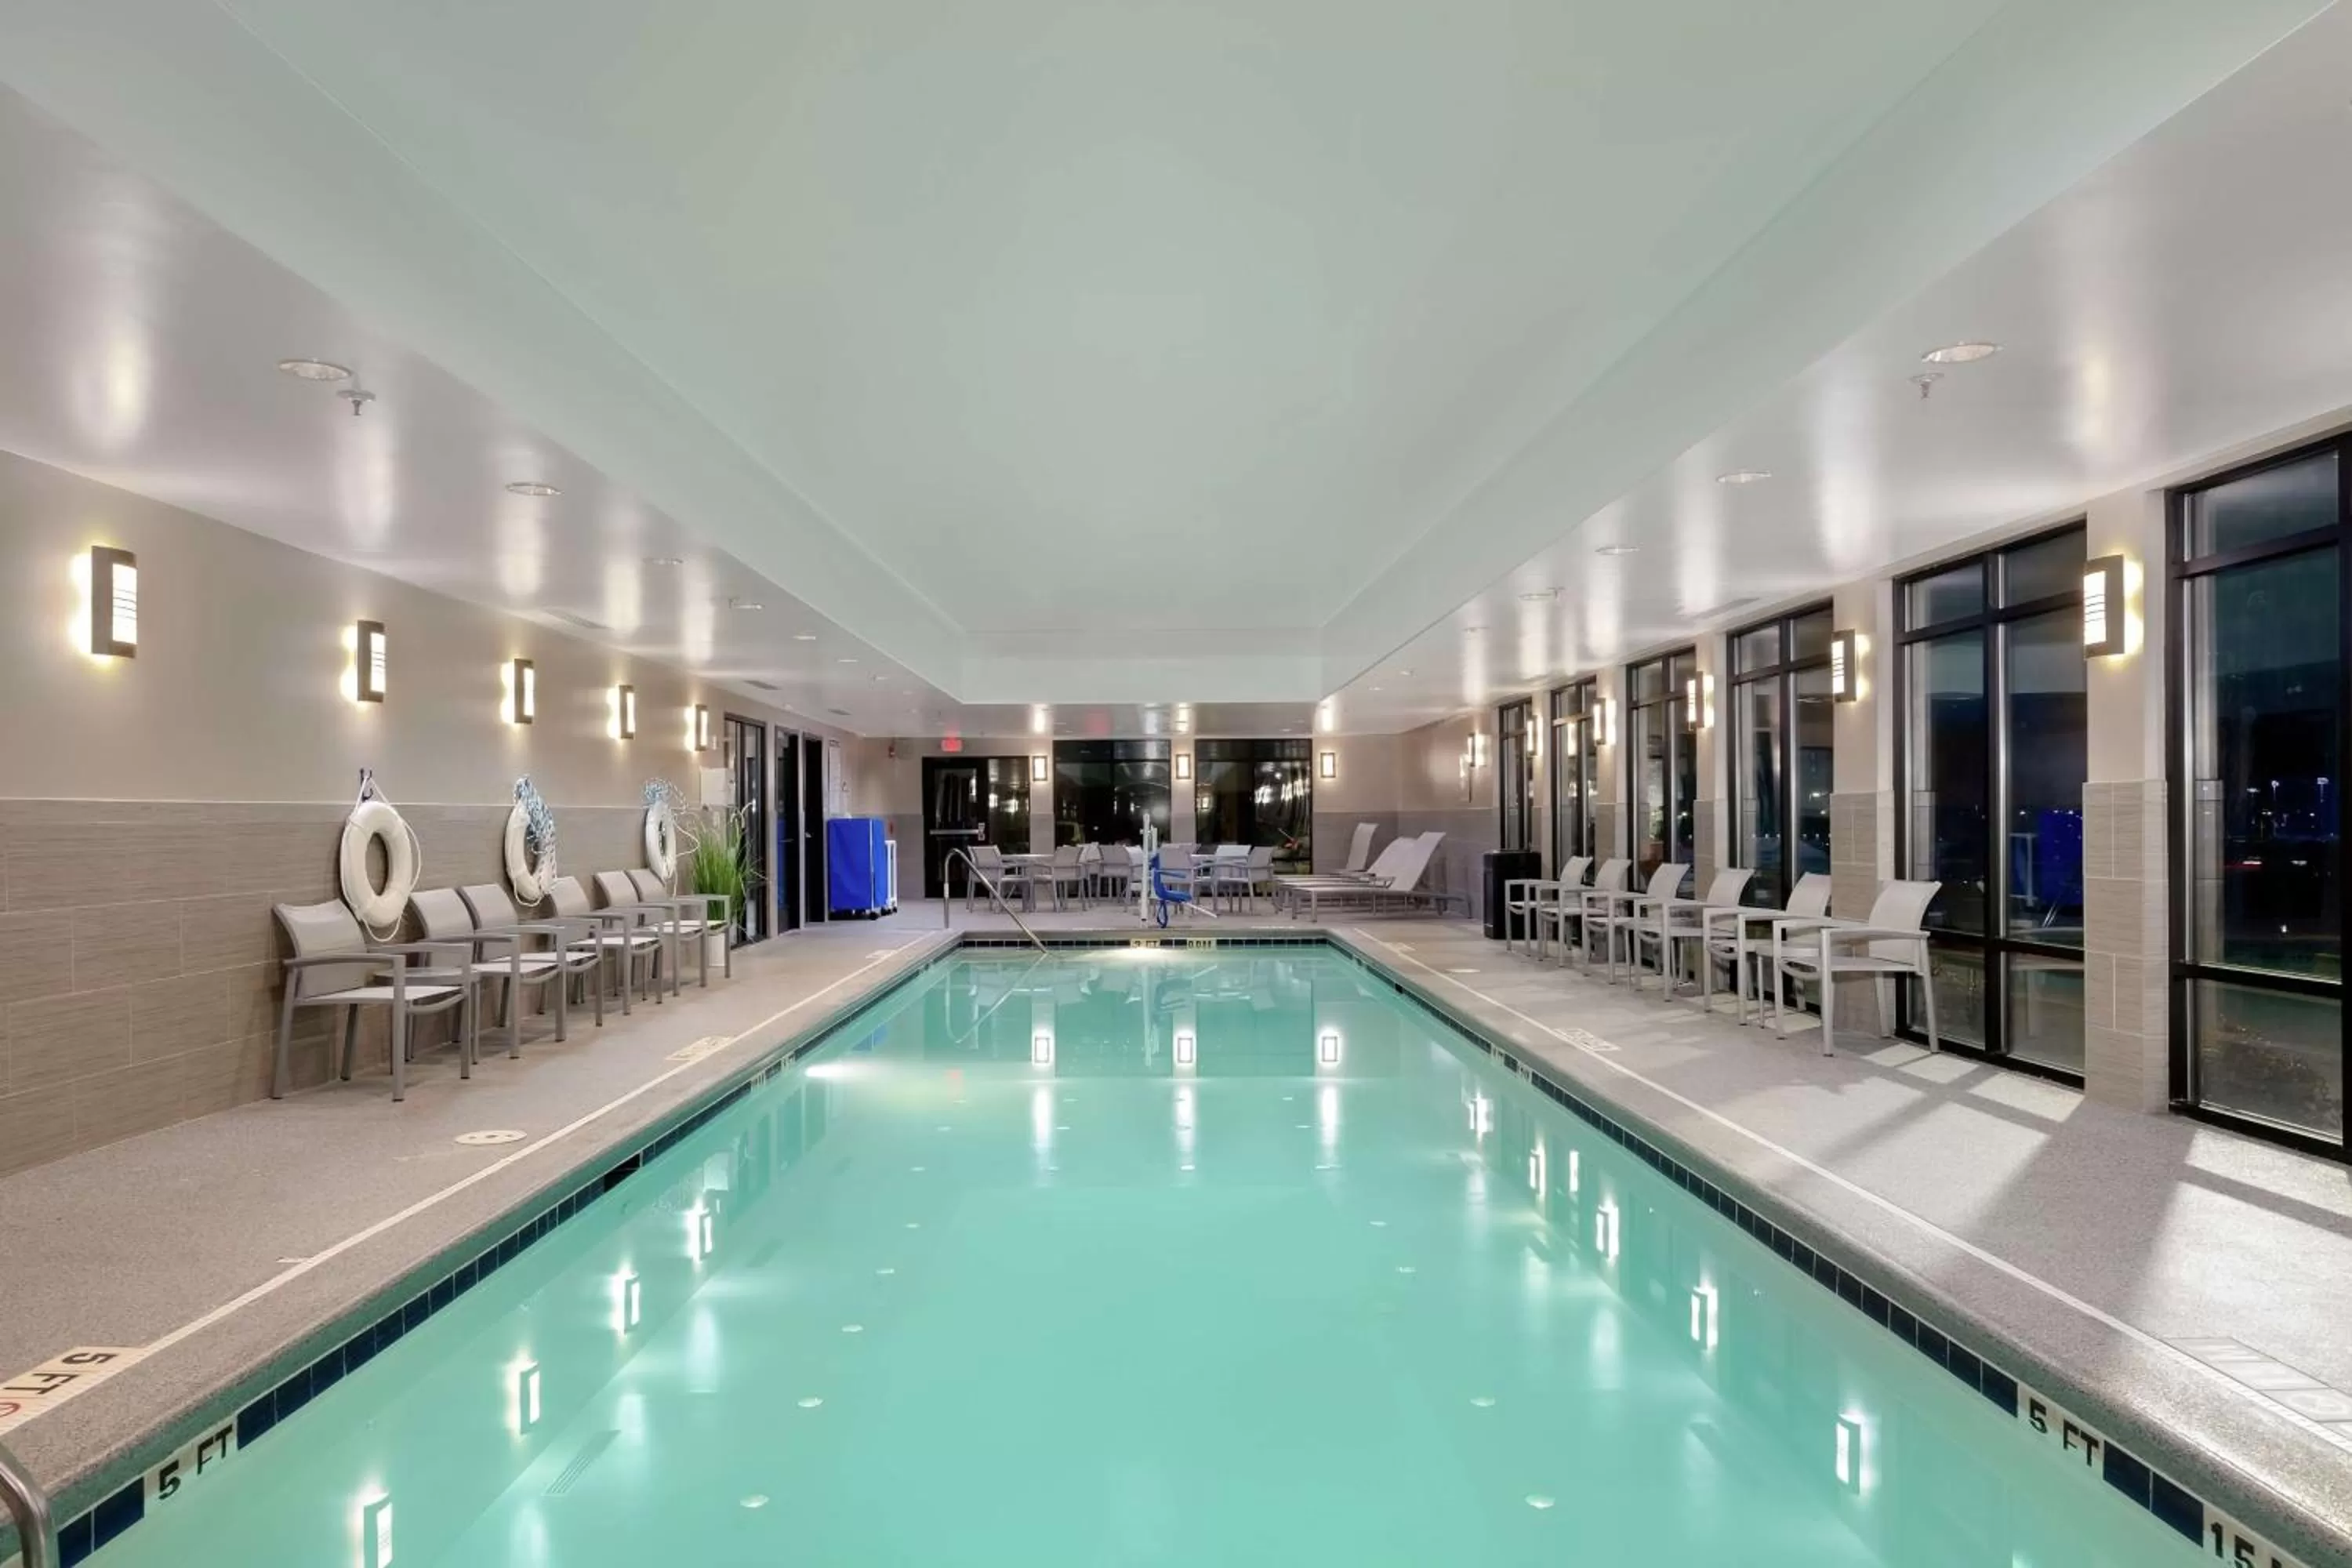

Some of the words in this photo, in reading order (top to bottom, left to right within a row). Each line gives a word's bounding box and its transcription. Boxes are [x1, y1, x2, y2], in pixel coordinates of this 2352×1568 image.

[61, 1352, 119, 1364] 5
[3, 1373, 81, 1395] FT
[2030, 1397, 2047, 1433] 5
[2063, 1418, 2099, 1468] FT
[158, 1460, 180, 1500] 5
[198, 1424, 233, 1475] FT
